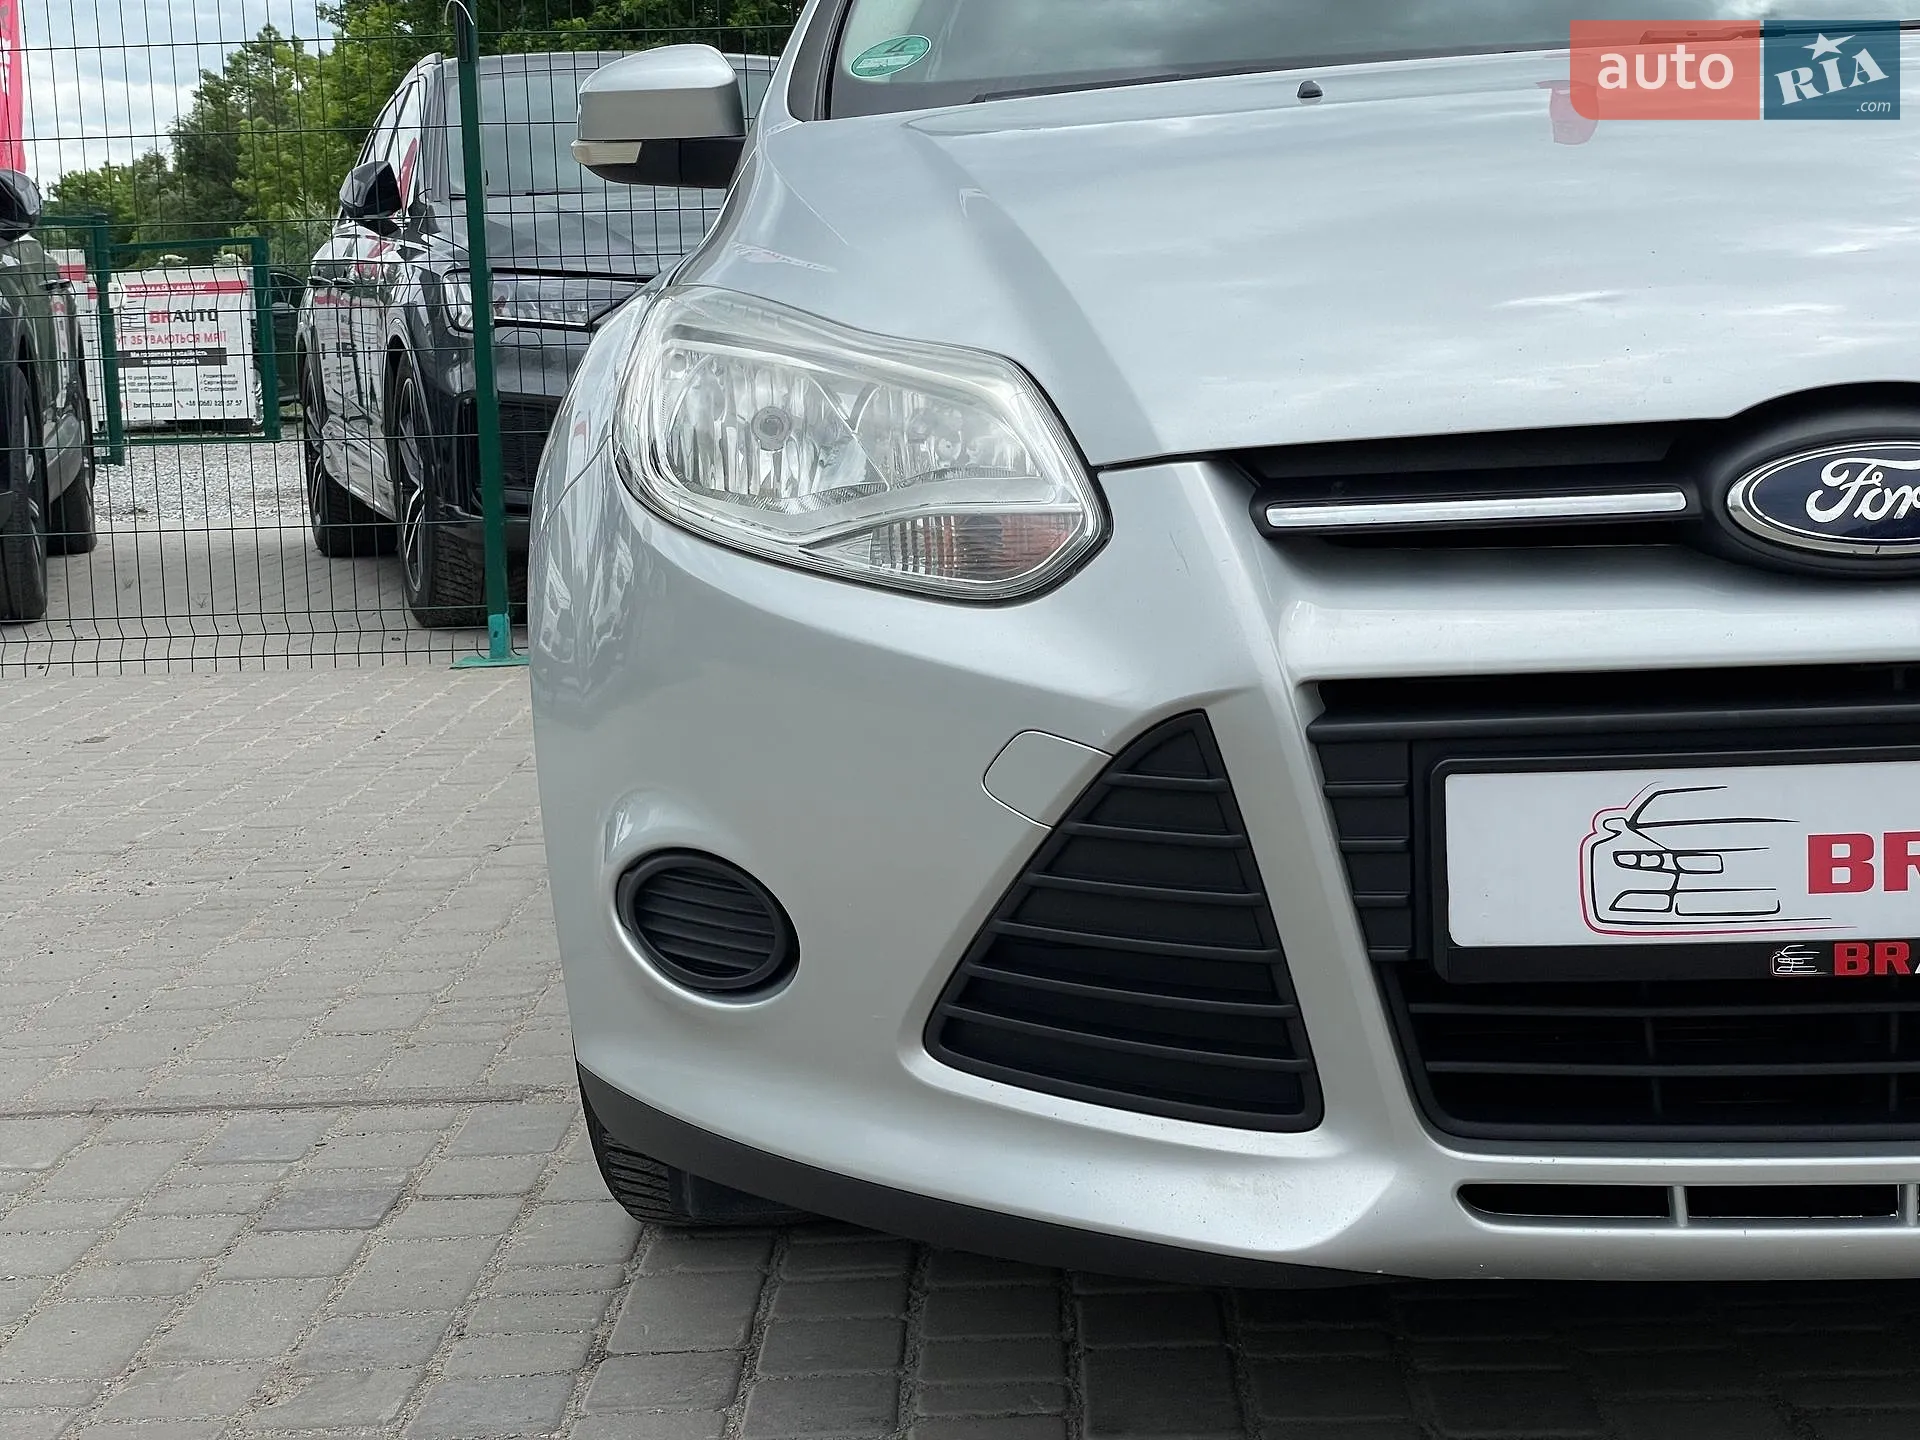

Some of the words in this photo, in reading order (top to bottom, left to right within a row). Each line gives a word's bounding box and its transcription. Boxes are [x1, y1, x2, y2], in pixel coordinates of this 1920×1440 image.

[149, 308, 219, 324] BRAUTO
[1806, 457, 1920, 523] For
[1834, 941, 1920, 977] BR
